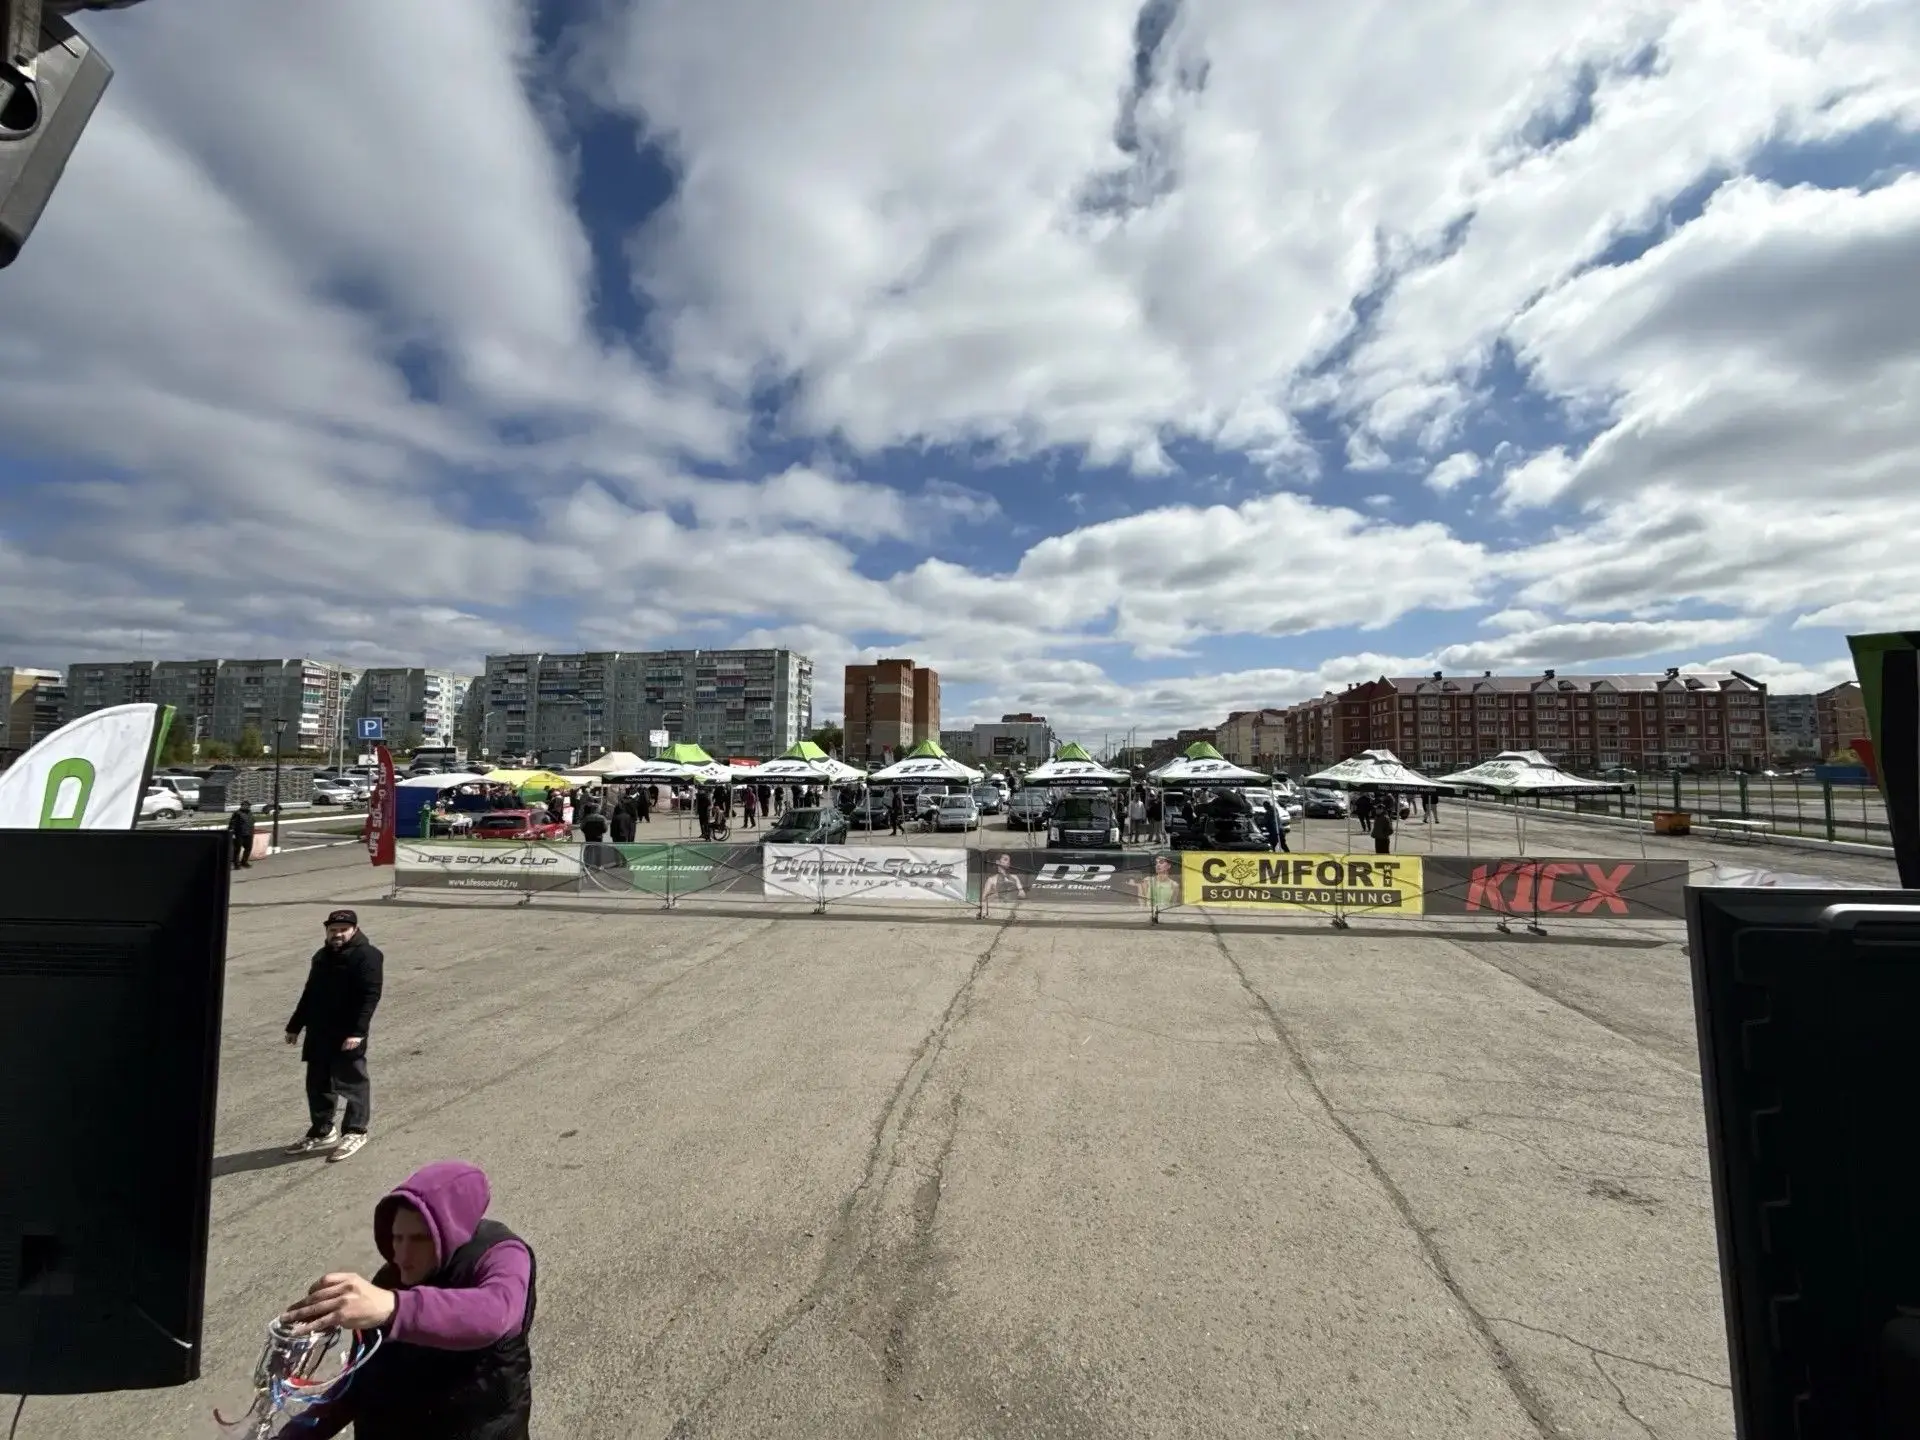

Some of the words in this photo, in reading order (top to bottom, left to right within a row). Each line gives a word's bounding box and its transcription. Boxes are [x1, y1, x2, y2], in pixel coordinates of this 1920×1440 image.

[365, 720, 377, 736] P
[369, 831, 380, 857] LIFE
[379, 762, 387, 785] CUP
[418, 855, 453, 863] LIFE
[455, 856, 516, 865] SOUND
[519, 857, 558, 866] CUP
[771, 855, 877, 881] Dynamic
[448, 878, 518, 888] www.lifesound42.ru
[807, 878, 951, 889] TECHNOLOGY
[1465, 862, 1635, 914] KICX
[1209, 889, 1271, 899] SOUND
[1281, 891, 1393, 904] DEADENING
